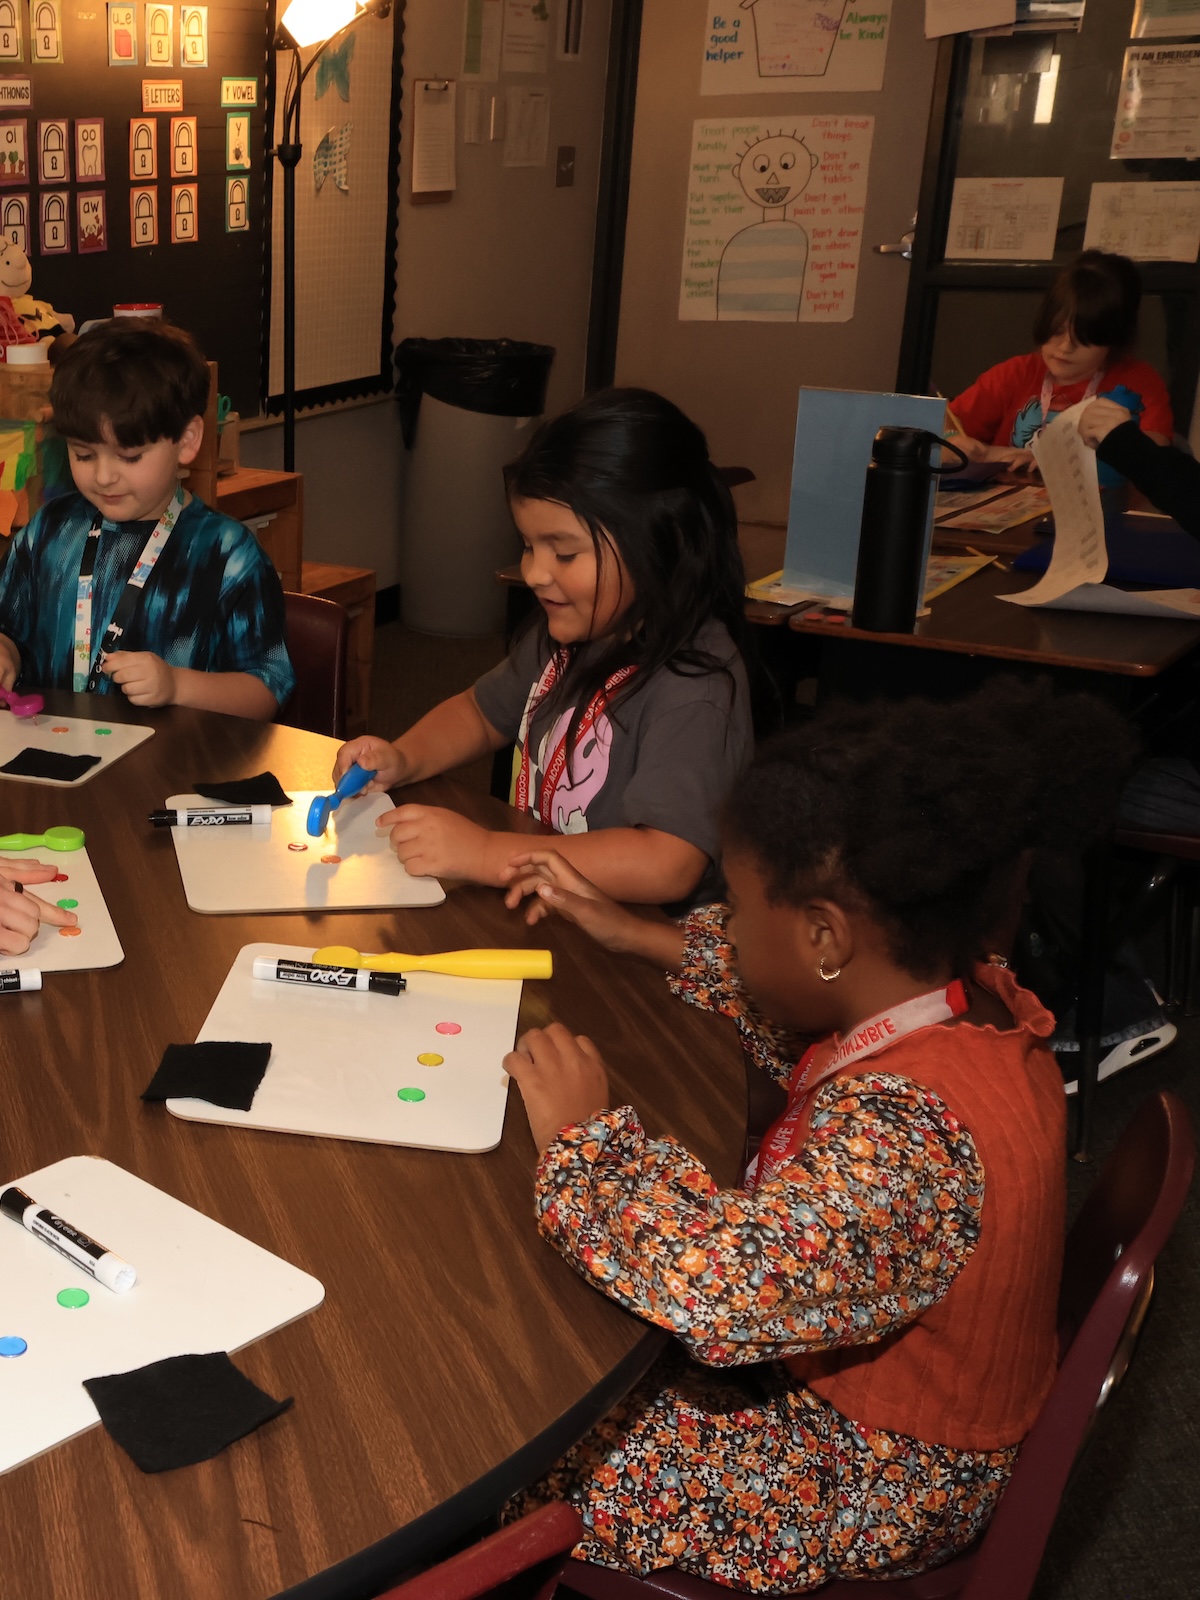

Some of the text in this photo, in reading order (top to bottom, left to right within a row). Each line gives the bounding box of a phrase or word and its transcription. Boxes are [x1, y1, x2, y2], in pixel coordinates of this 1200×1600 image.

[712, 16, 741, 30] Be a
[846, 12, 889, 26] Always
[710, 31, 739, 49] good
[705, 48, 744, 64] helper
[150, 88, 180, 103] LETTERS
[225, 86, 254, 100] Y VOWEL
[81, 128, 97, 142] oo
[82, 200, 100, 214] aw
[190, 815, 226, 826] EXPO
[310, 968, 355, 986] EXPO
[770, 1126, 795, 1154] SAFE
